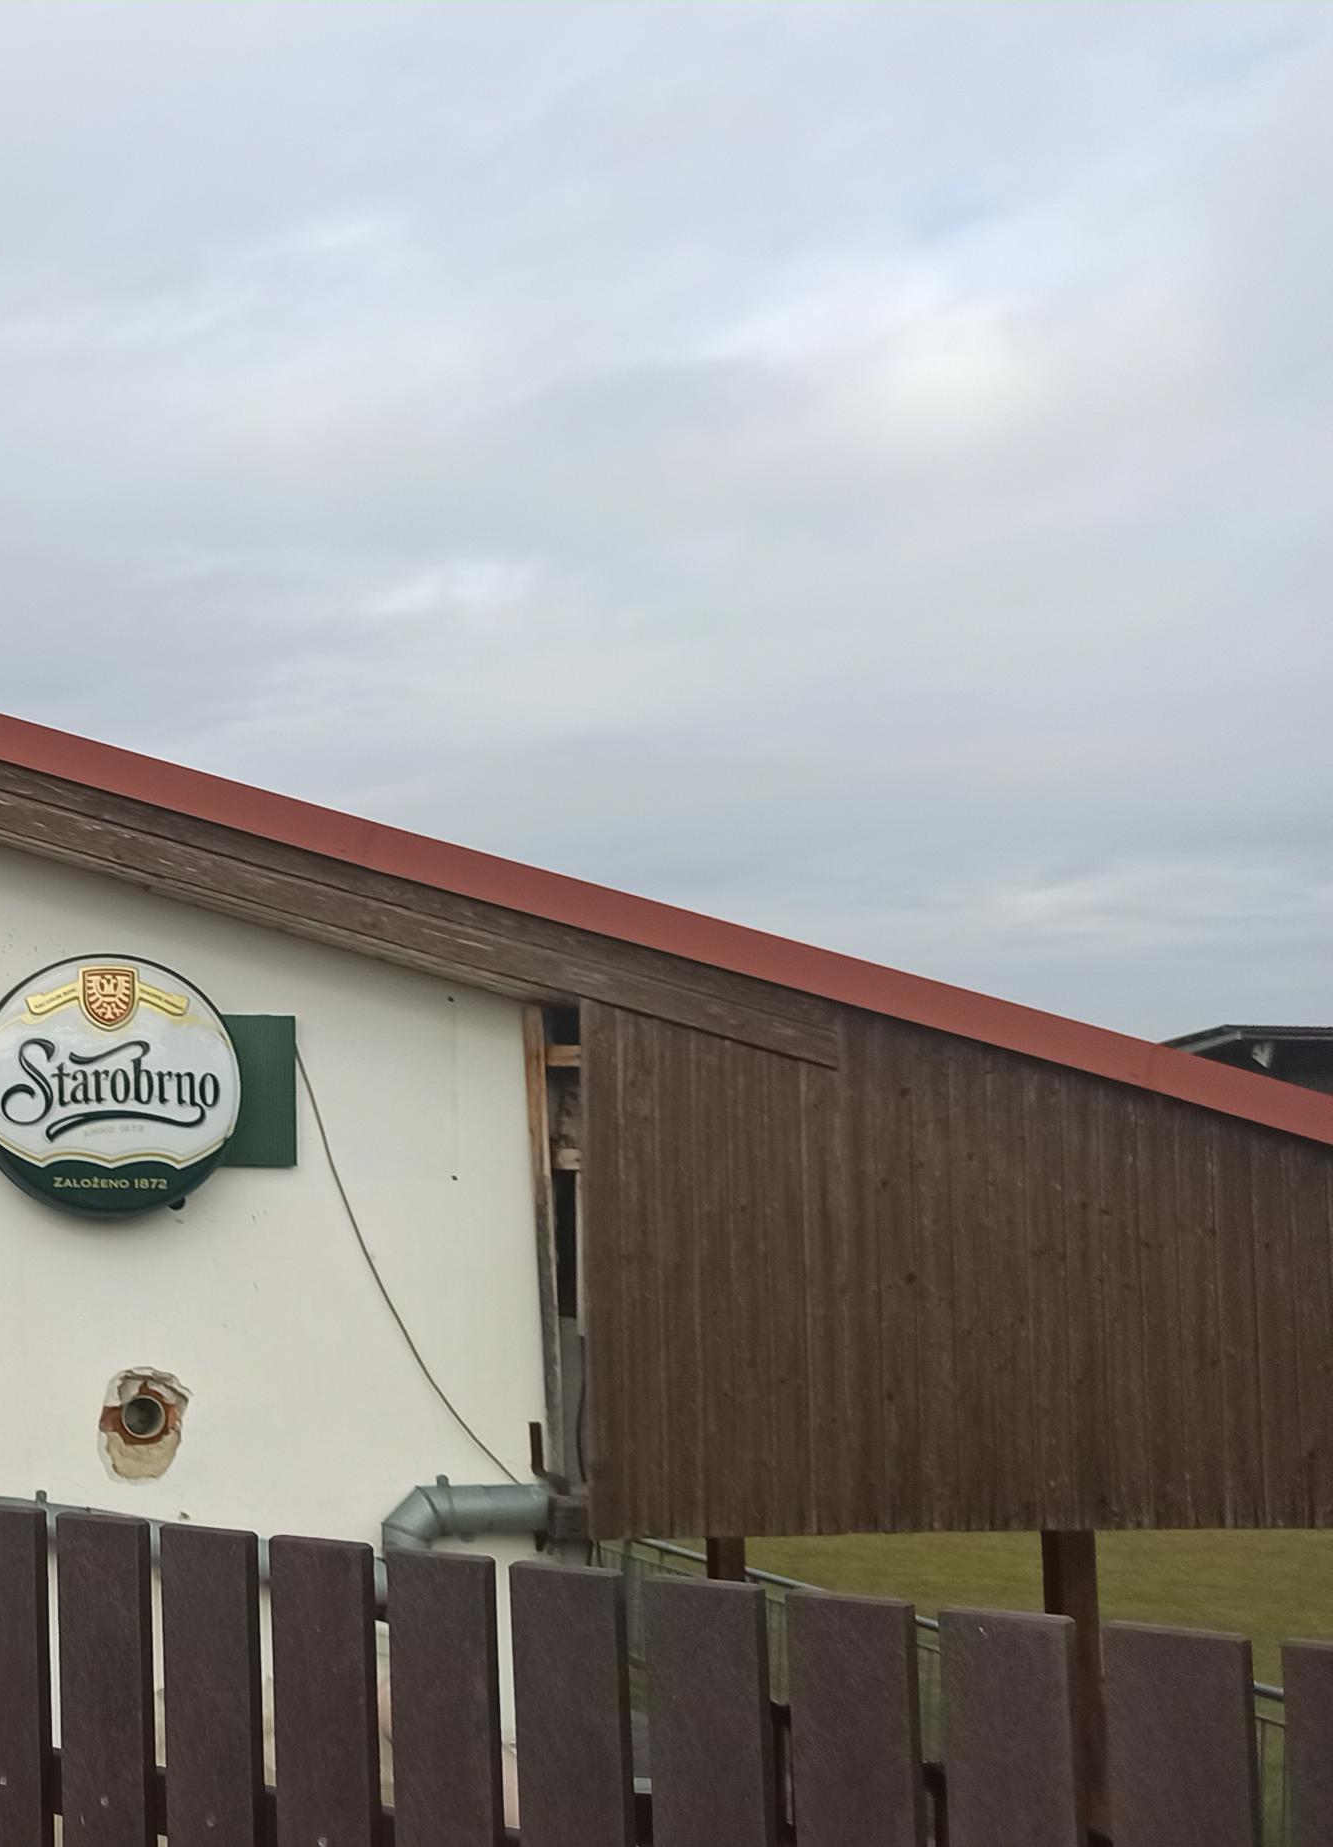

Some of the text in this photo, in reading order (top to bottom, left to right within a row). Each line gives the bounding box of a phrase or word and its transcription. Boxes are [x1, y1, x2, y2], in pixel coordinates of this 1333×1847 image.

[0, 1037, 221, 1143] Starobrno
[52, 1175, 168, 1190] ZALOŽENO 1872
